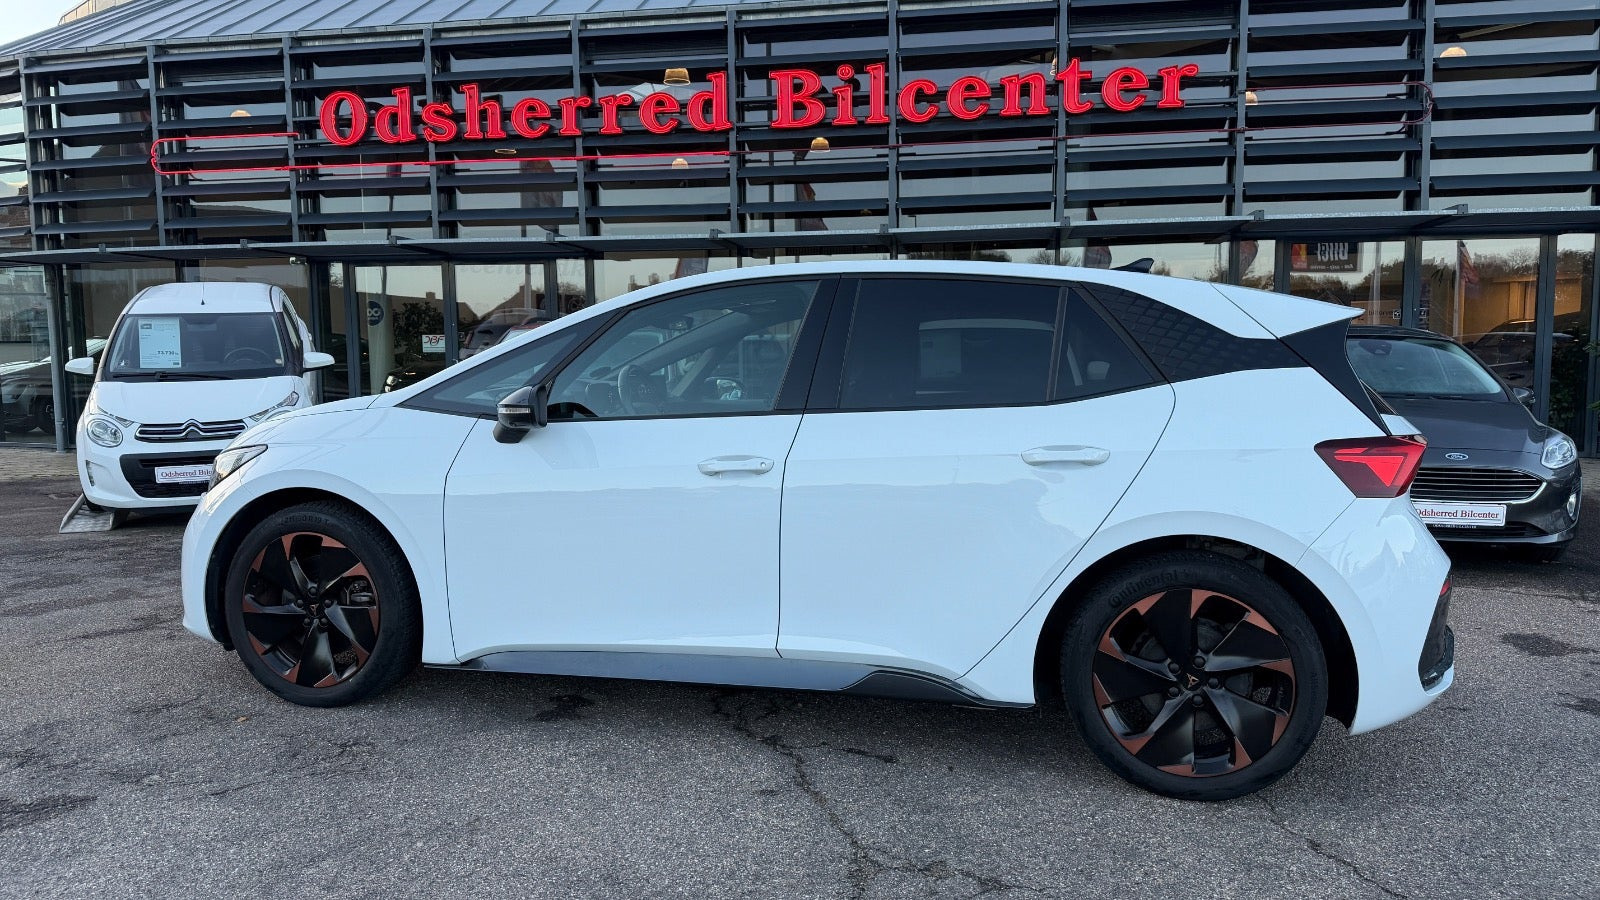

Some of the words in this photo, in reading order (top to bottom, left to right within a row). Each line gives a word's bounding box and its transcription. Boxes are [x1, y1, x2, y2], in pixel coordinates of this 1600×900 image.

[320, 71, 733, 146] Odsherred
[769, 57, 1199, 129] Bilcenter
[161, 470, 197, 478] Odsherred
[1460, 510, 1499, 519] Bilcenter
